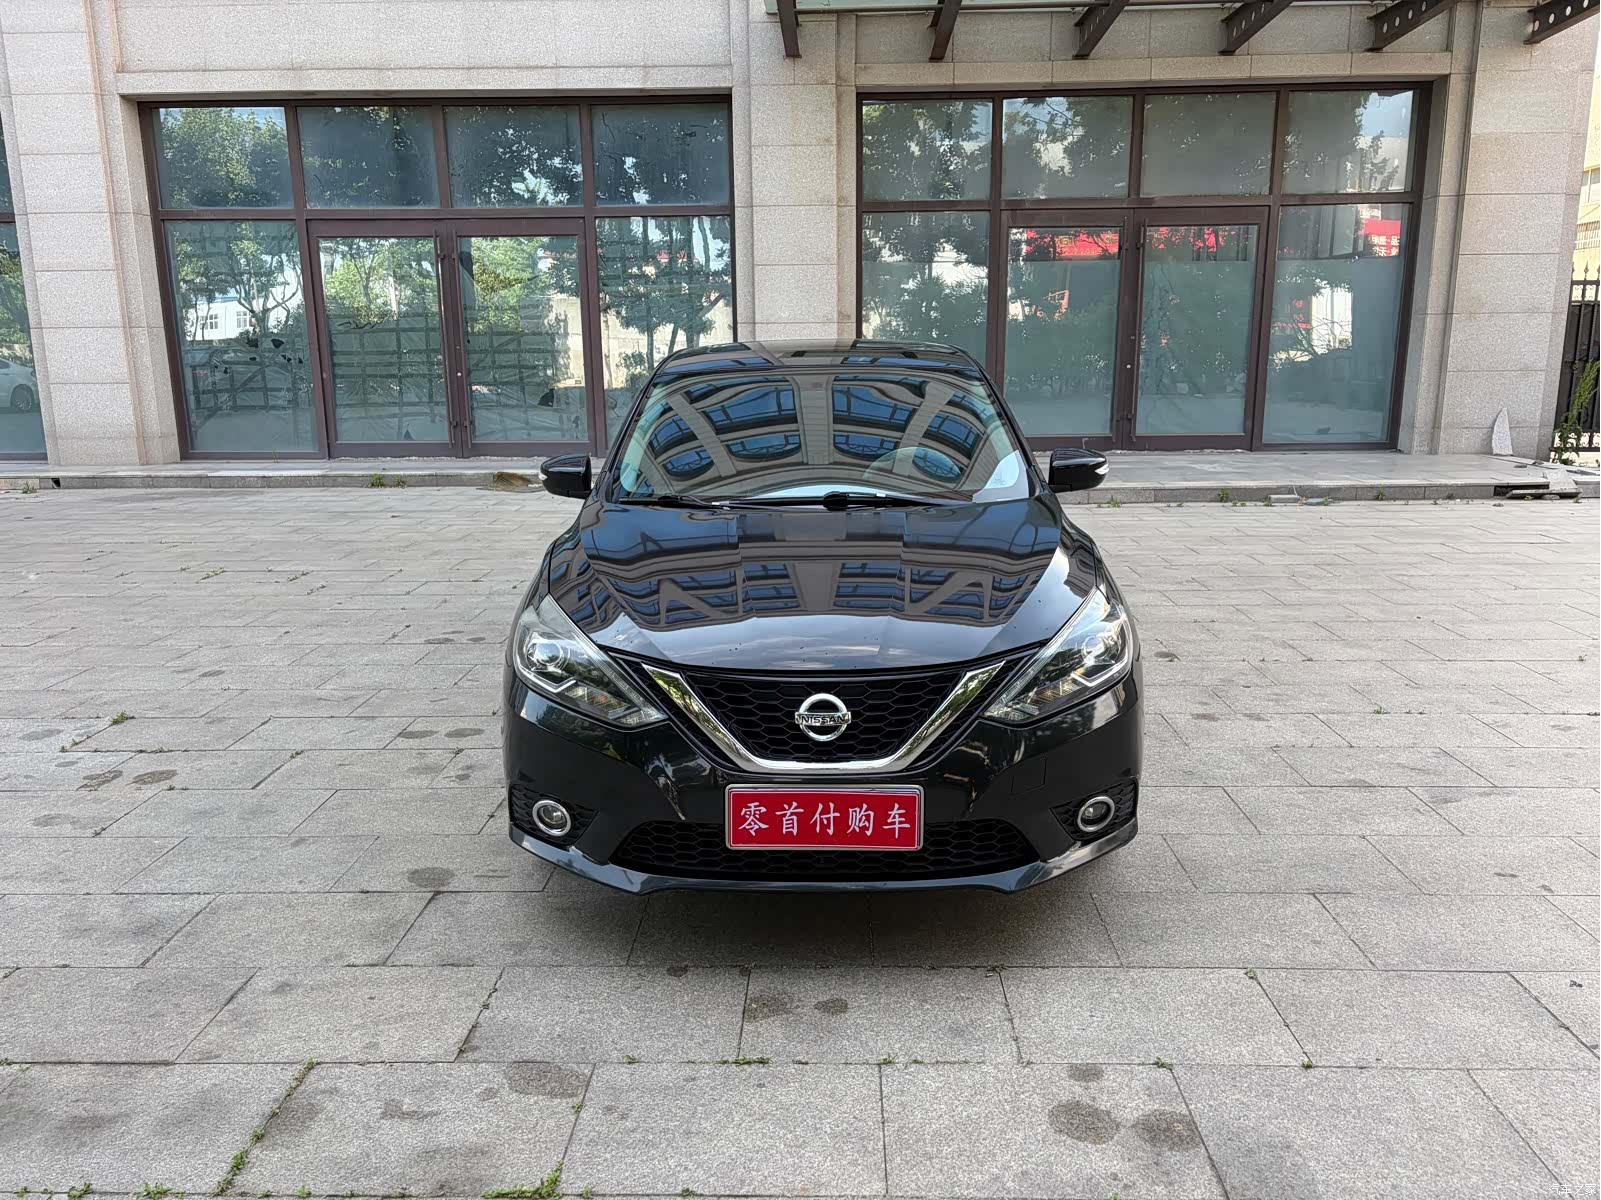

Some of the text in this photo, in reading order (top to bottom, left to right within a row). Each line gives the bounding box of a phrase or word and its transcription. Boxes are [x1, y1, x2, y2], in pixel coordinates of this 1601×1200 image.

[800, 714, 846, 725] NISSAN
[738, 801, 911, 839] 零首付购车
